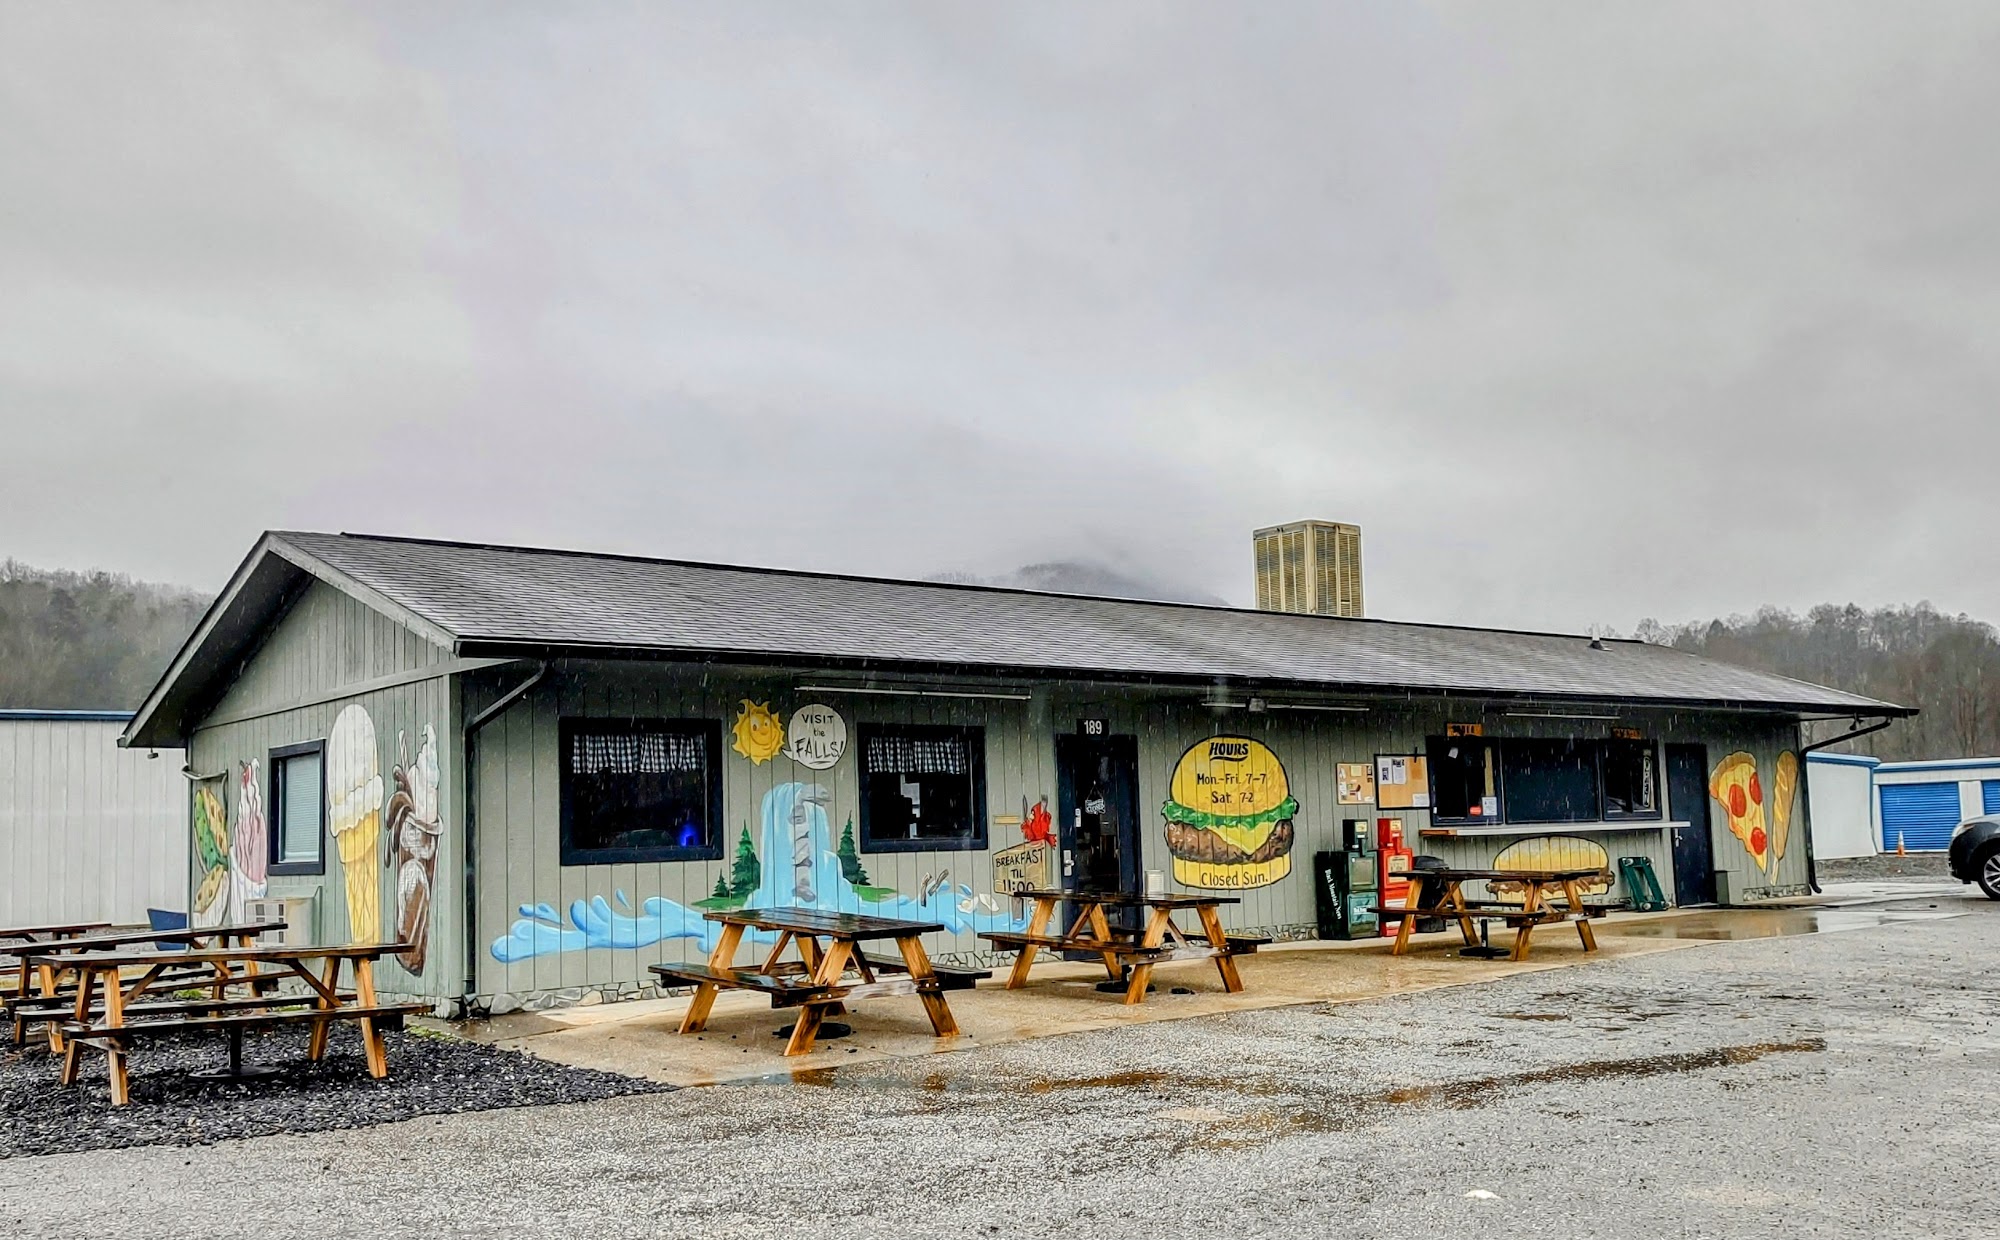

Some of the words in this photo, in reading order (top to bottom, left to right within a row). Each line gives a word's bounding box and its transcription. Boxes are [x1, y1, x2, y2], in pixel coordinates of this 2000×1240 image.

[801, 714, 834, 724] VISIT
[813, 728, 826, 737] the
[1084, 720, 1102, 734] 189
[795, 737, 844, 758] FALLS!
[1209, 742, 1249, 756] HOURS
[1211, 790, 1233, 804] Sat.
[1239, 791, 1254, 804] 7-2
[995, 847, 1045, 867] BREAKFAST
[1010, 868, 1024, 879] TIL
[1201, 870, 1239, 886] Closed
[1243, 871, 1269, 886] Sun.
[1003, 879, 1035, 893] 11:00
